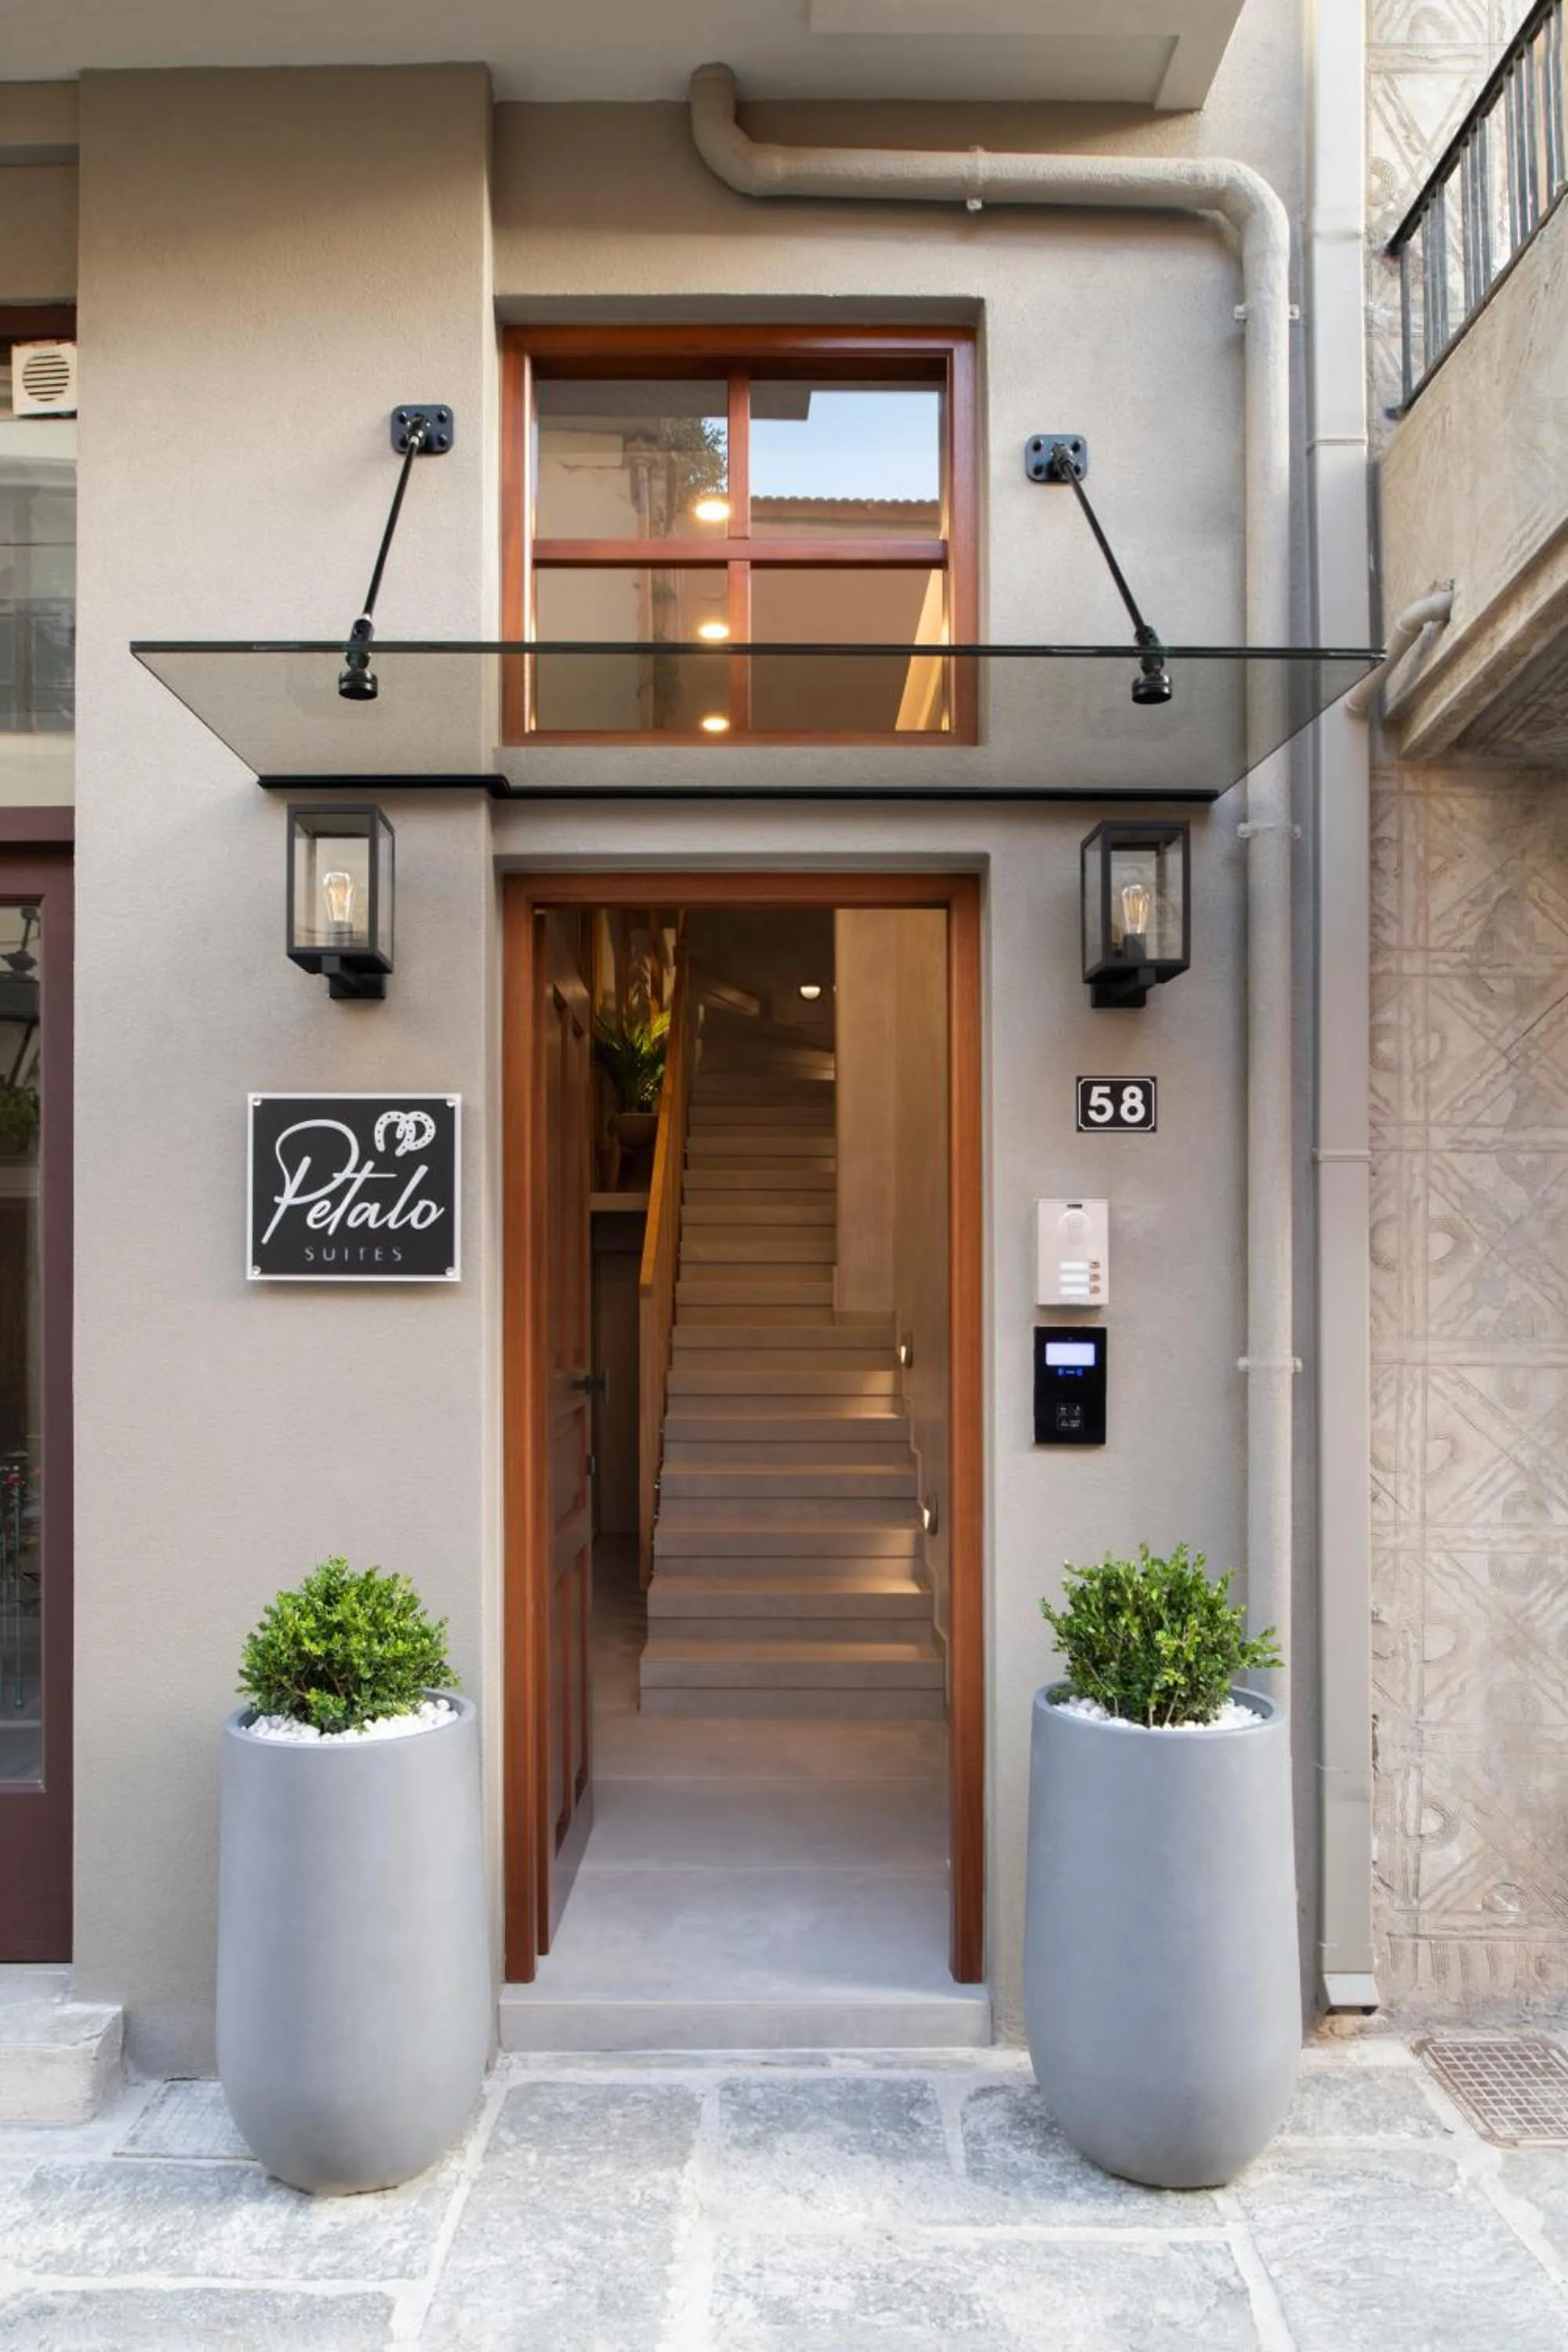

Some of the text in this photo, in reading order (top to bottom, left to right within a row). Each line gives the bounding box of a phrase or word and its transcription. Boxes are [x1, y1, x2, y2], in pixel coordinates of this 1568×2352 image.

[1087, 1085, 1145, 1123] 58
[261, 1119, 445, 1244] Petalo
[304, 1246, 403, 1261] SUITES
